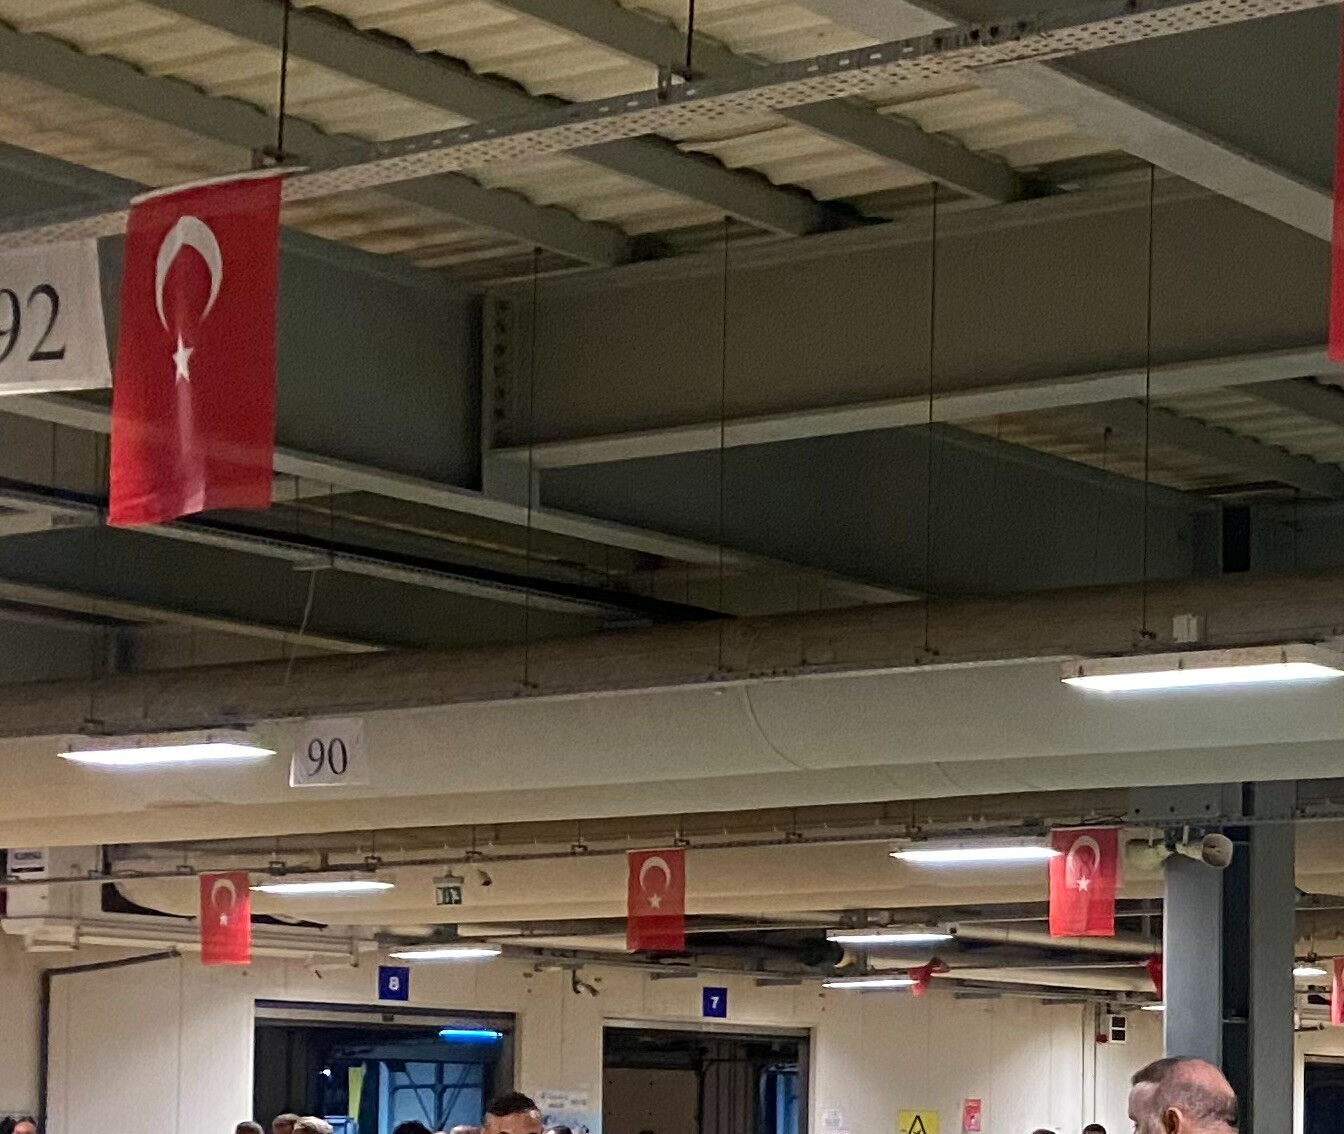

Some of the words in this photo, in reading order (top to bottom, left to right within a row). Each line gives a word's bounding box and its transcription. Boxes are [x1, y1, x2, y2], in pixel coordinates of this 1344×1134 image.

[0, 283, 66, 362] 92
[307, 738, 348, 777] 90
[389, 976, 398, 991] 8
[710, 996, 718, 1009] 7
